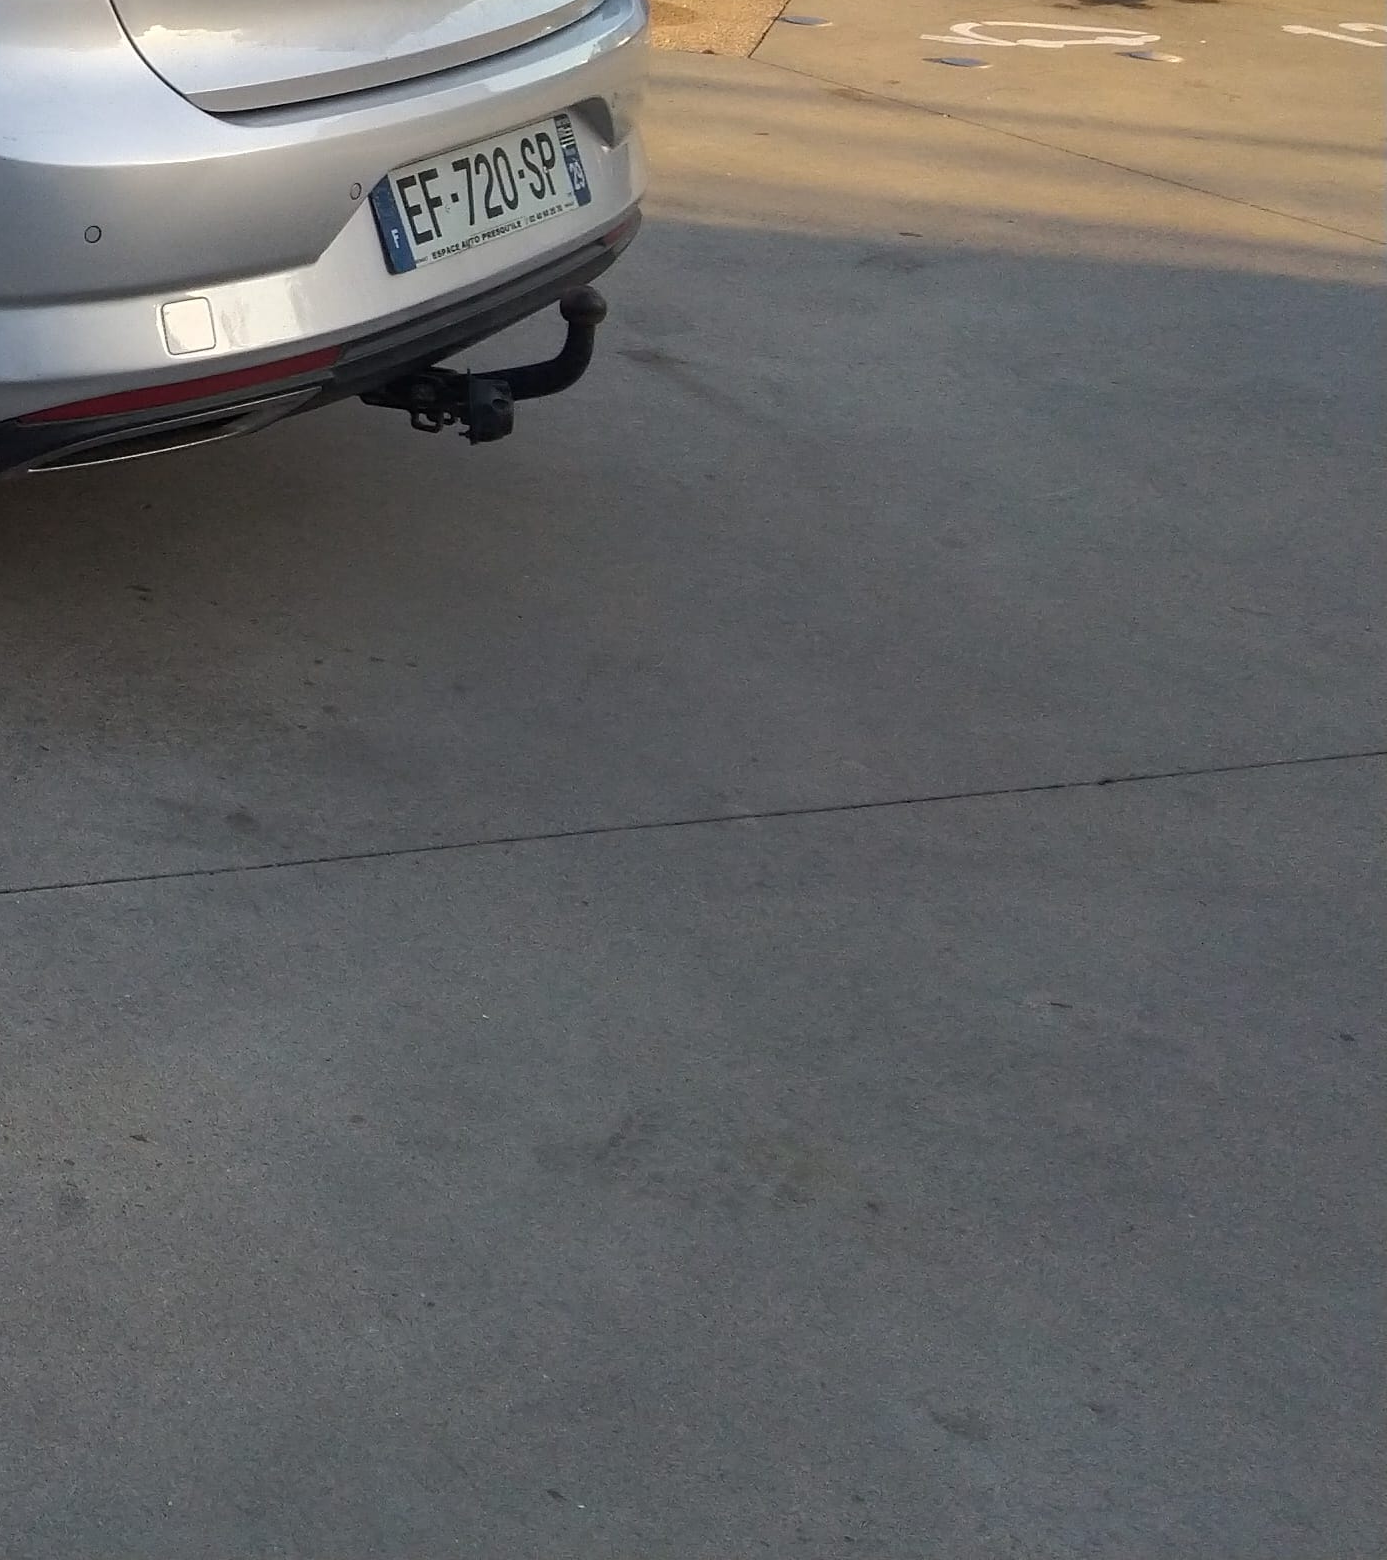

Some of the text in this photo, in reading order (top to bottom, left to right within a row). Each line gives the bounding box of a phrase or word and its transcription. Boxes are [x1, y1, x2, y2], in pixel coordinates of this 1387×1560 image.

[396, 132, 556, 246] EF-720-SP
[391, 228, 401, 249] F
[431, 244, 461, 260] ESPACE
[461, 235, 481, 250] AUTO
